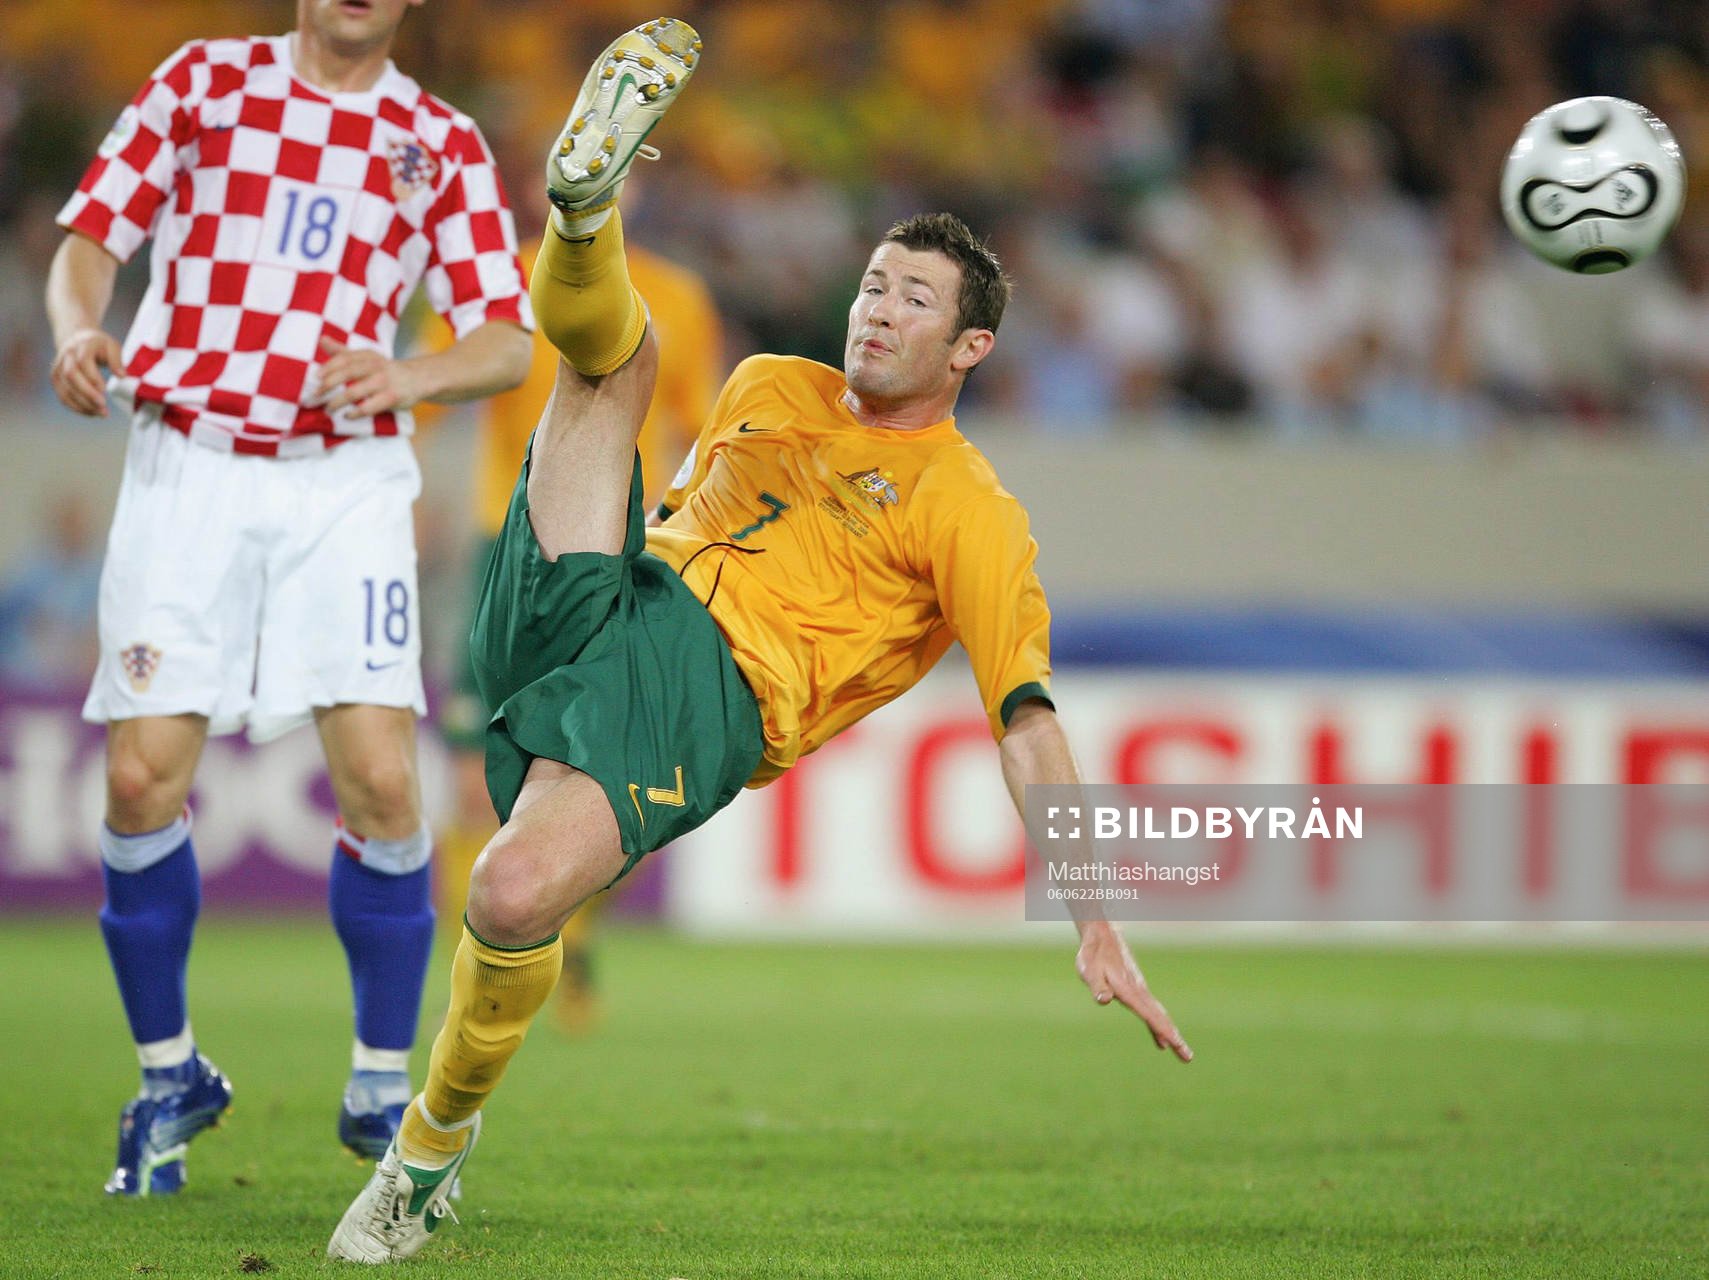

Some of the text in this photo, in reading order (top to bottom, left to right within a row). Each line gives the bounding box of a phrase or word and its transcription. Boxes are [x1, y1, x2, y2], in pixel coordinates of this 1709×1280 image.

[278, 190, 337, 260] 18
[730, 490, 790, 541] 7
[363, 578, 408, 647] 18
[646, 765, 686, 807] 7
